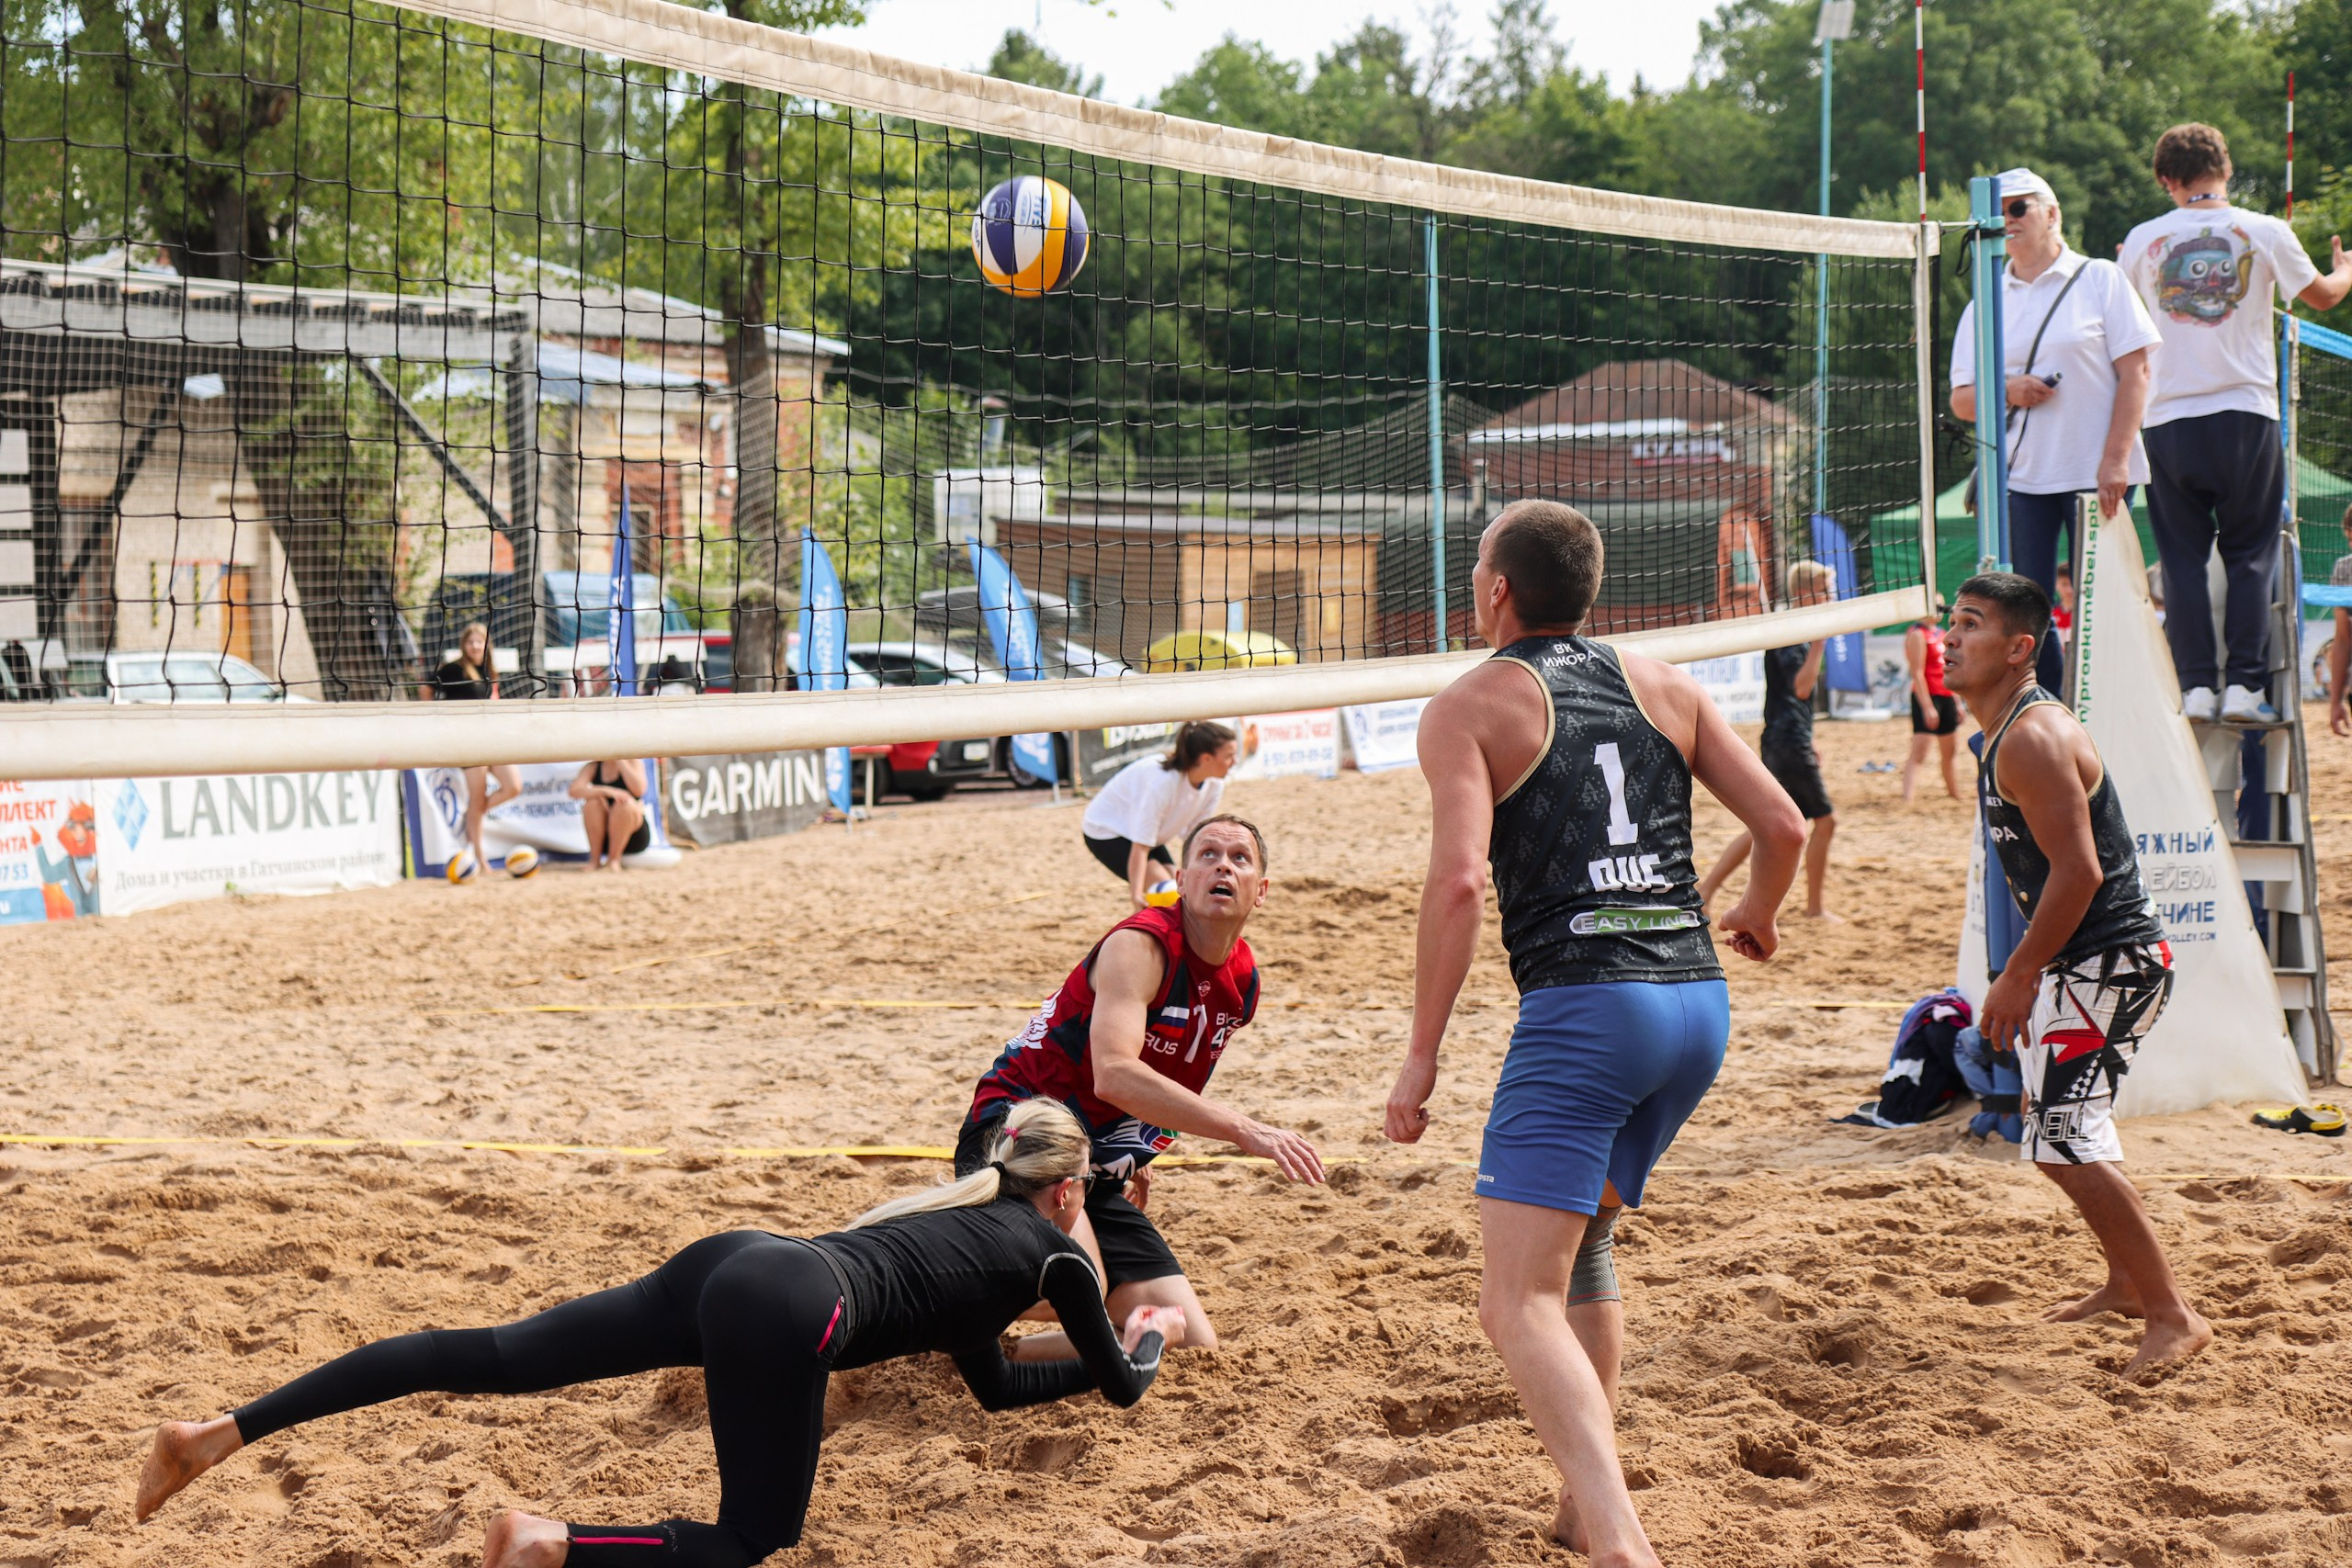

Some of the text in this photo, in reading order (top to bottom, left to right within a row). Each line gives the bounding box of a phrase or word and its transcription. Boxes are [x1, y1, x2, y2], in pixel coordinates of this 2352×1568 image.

[1543, 649, 1600, 667] ИЖОРА
[673, 754, 824, 820] GARMIN
[1593, 742, 1638, 846] 1
[160, 772, 384, 840] LANDKEY
[115, 870, 156, 891] Дома
[160, 869, 169, 884] и
[236, 865, 246, 878] в
[1580, 916, 1643, 931] EASY
[1145, 1032, 1179, 1055] RUS
